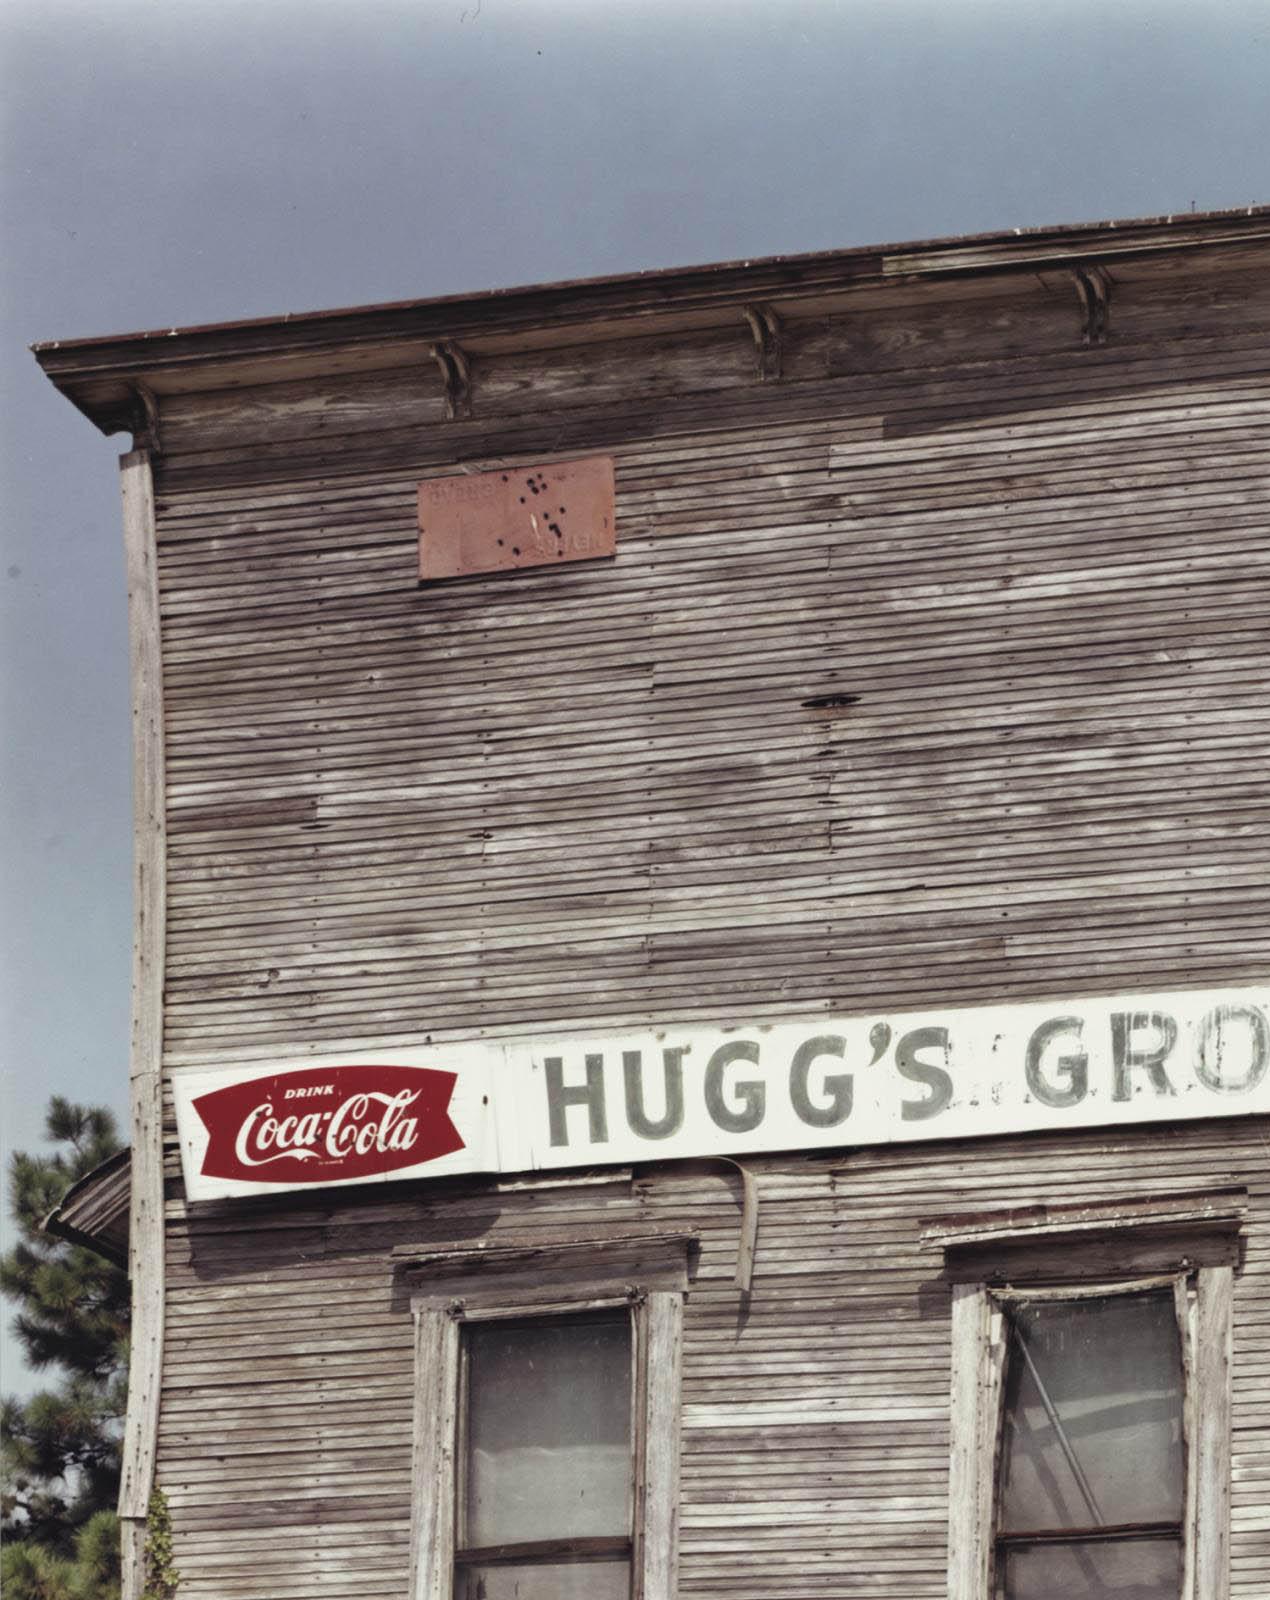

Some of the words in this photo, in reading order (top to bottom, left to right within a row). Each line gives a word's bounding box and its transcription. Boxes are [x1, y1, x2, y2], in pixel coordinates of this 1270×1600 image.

[284, 1084, 334, 1099] DRINK
[543, 1021, 953, 1146] HUGG'S
[234, 1087, 424, 1166] Coca-Cola
